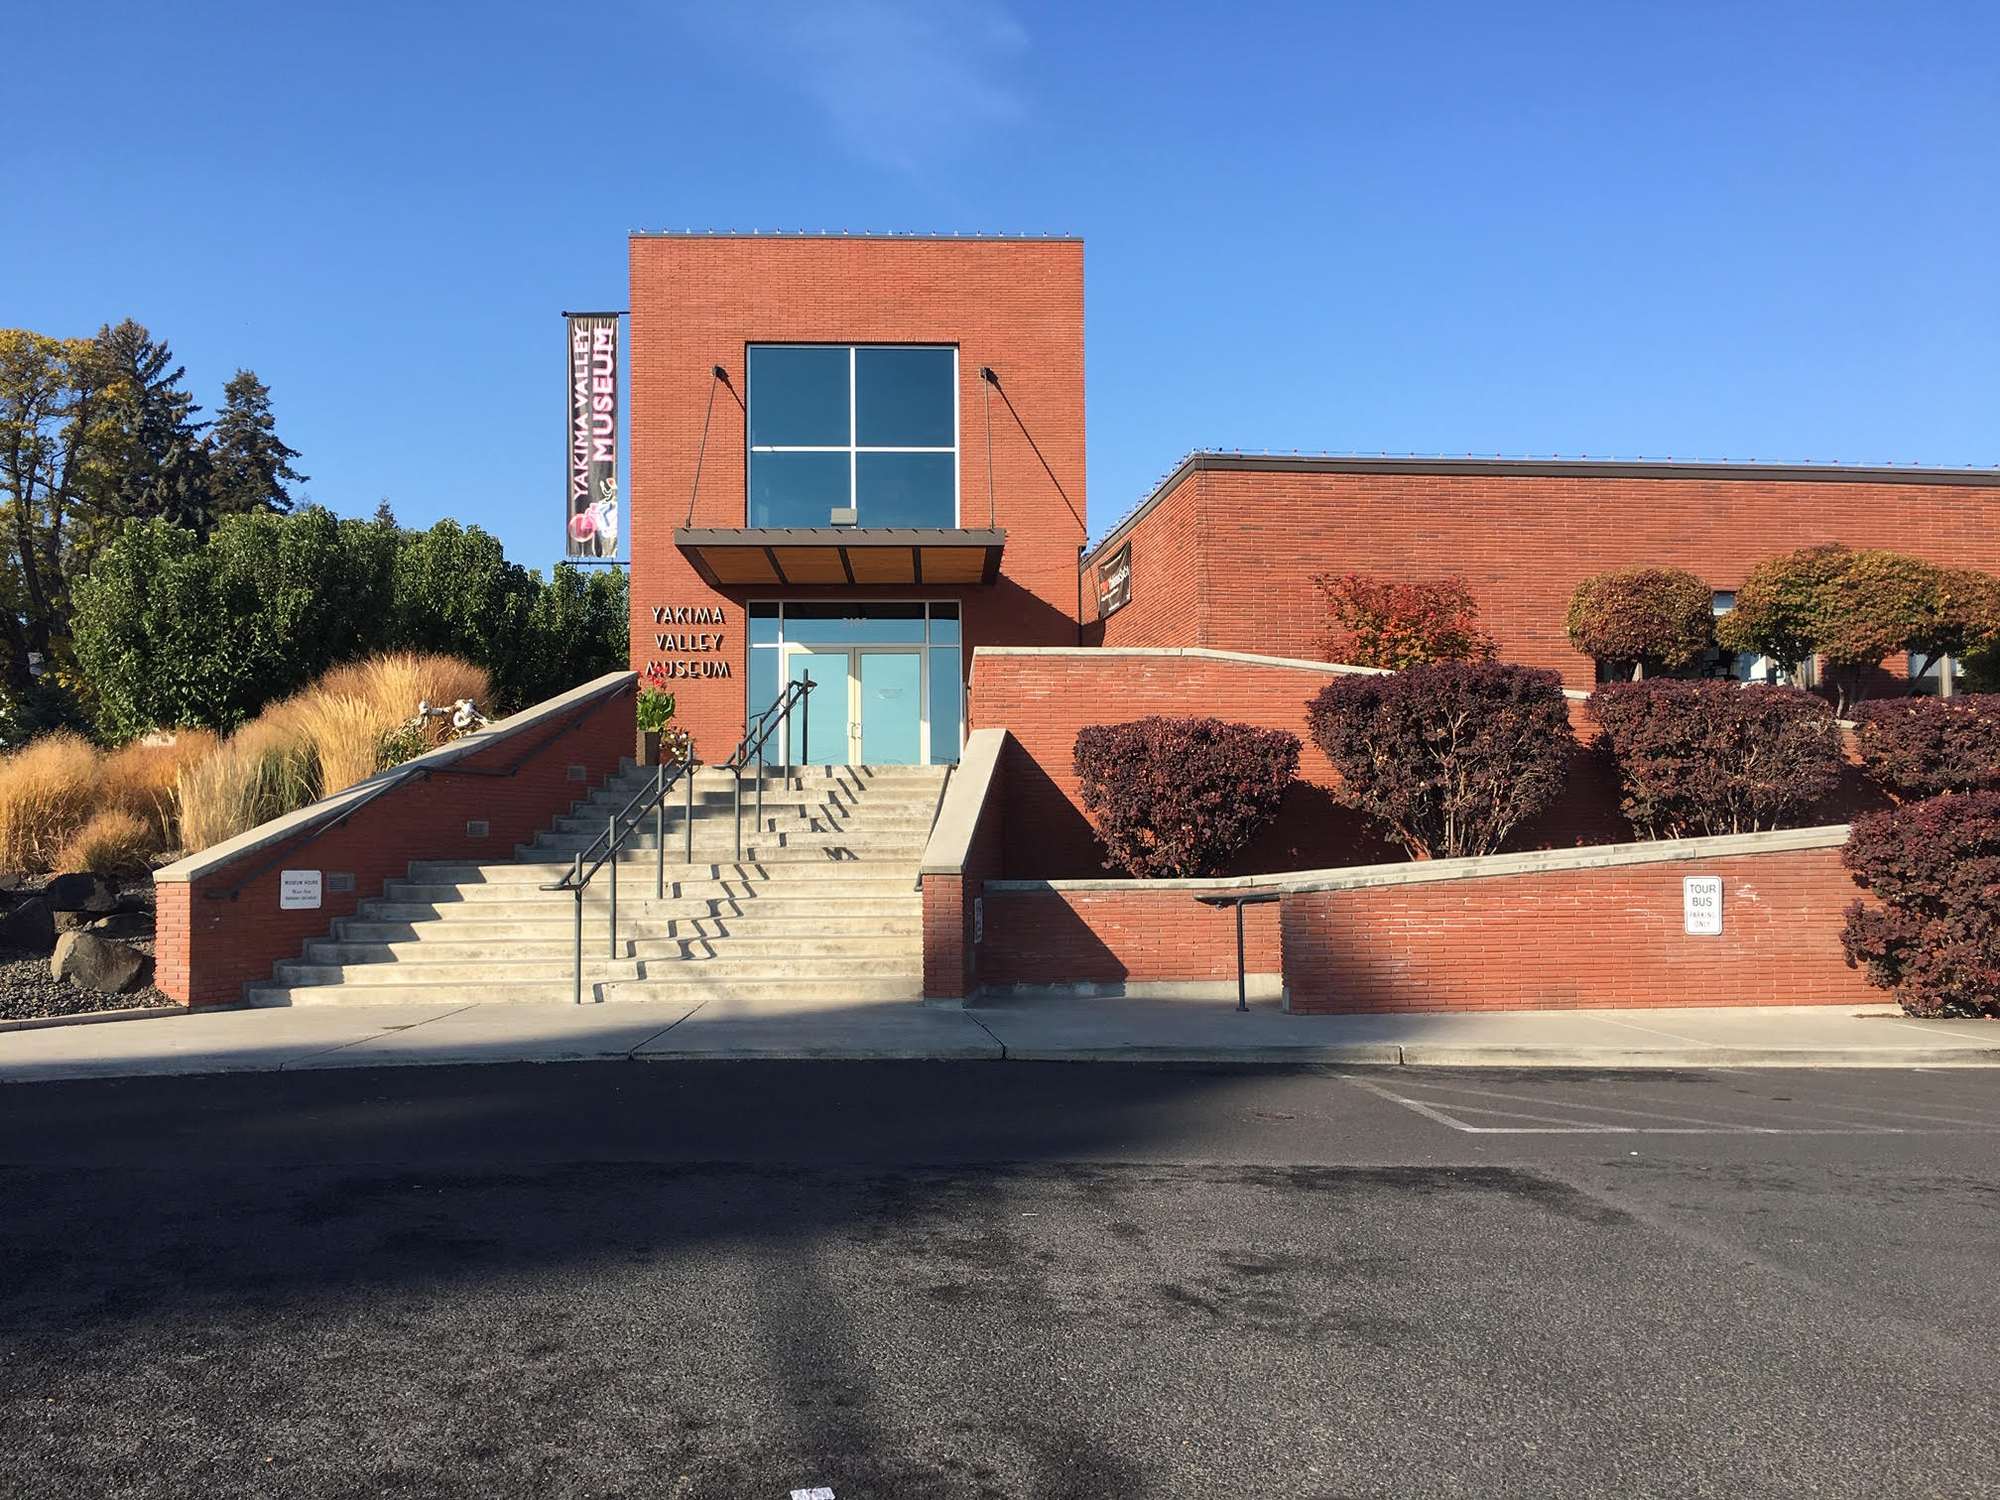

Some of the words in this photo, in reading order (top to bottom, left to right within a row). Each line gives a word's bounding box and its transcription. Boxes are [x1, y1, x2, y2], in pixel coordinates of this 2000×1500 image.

[574, 321, 589, 408] VALLEY
[592, 327, 614, 462] MUSEUM
[574, 413, 589, 500] YAKIMA
[651, 606, 724, 624] YAKIMA
[655, 633, 722, 651] VALLEY
[645, 660, 730, 677] MUSEUM
[1690, 884, 1717, 894] TOUR
[1692, 897, 1712, 907] BUS
